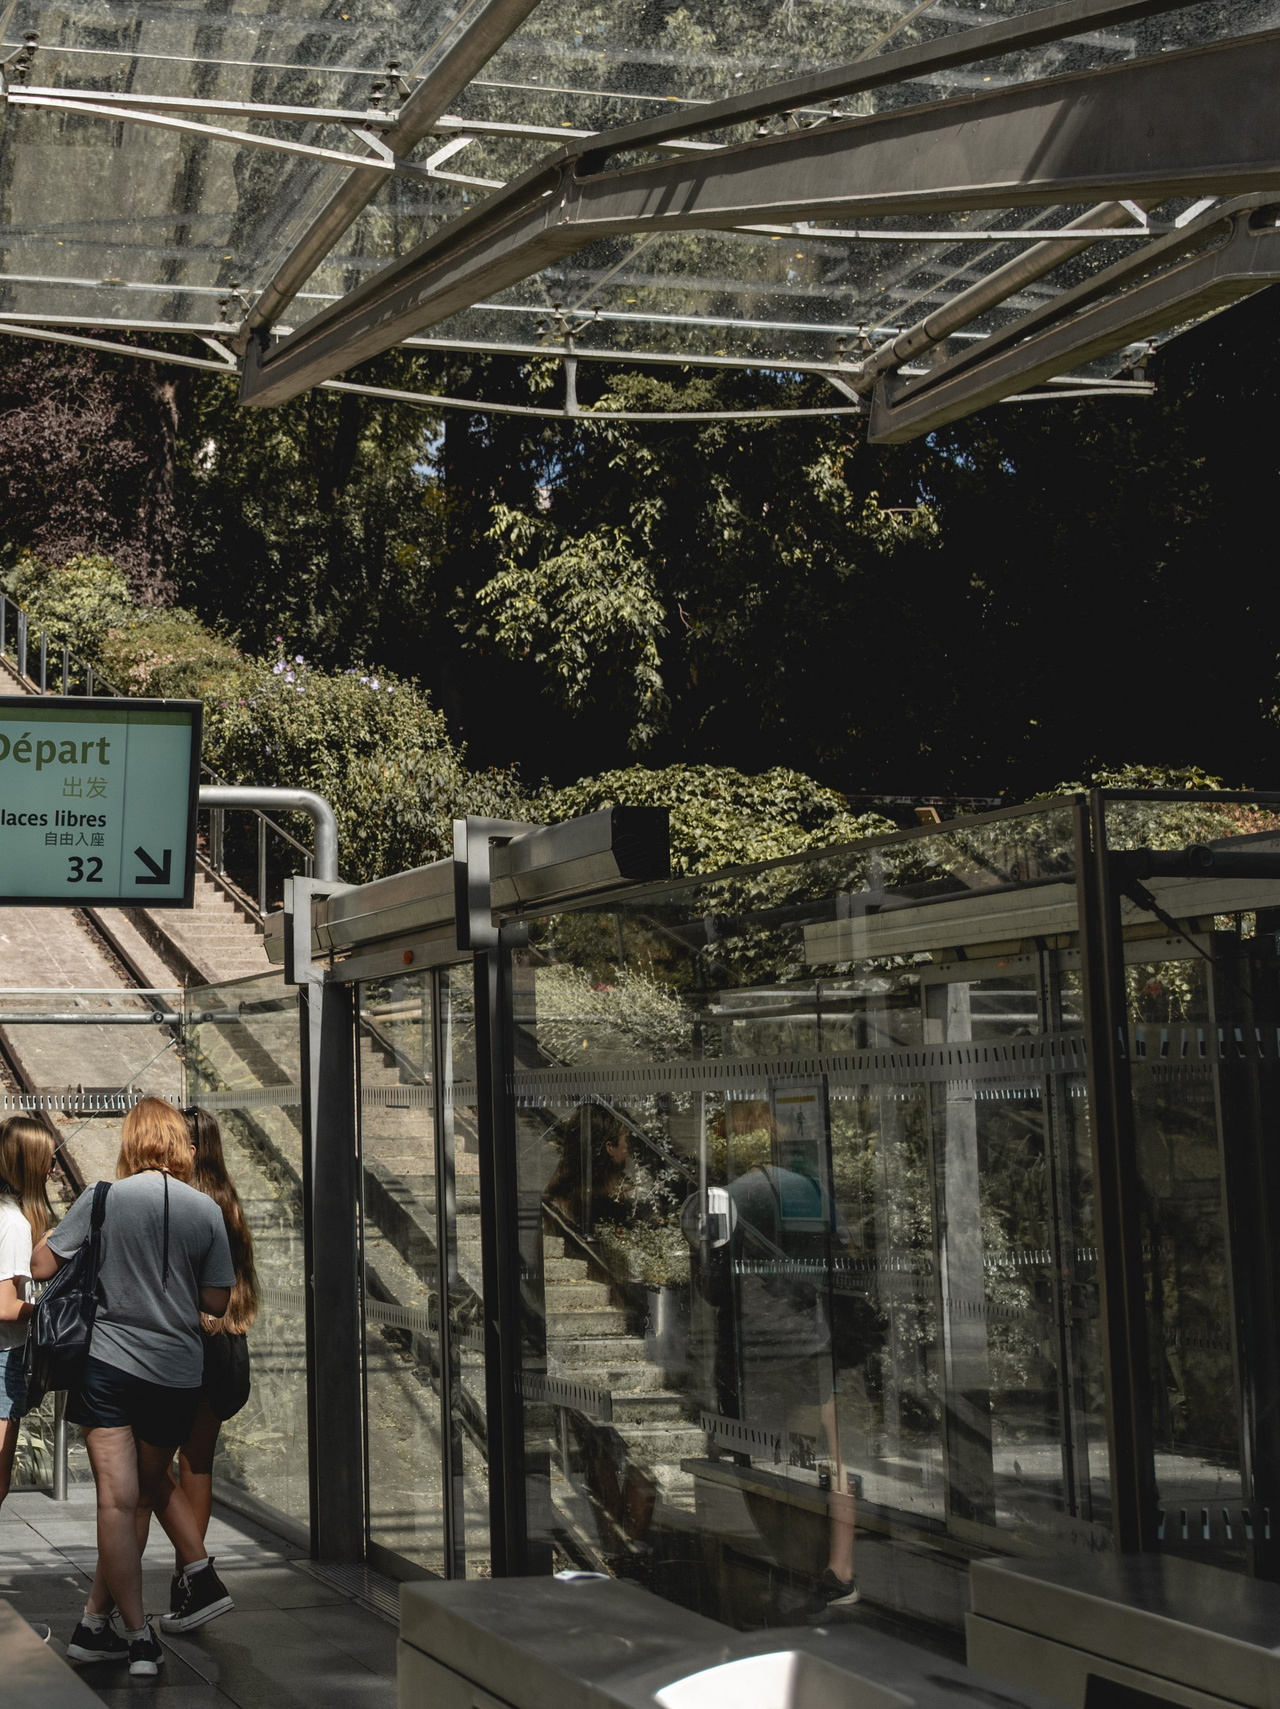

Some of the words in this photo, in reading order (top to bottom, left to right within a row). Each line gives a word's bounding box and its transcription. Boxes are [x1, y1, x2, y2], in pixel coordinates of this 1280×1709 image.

[63, 776, 108, 799] 出发
[55, 810, 106, 827] libres
[45, 832, 104, 846] 自由入座
[67, 857, 103, 882] 32
